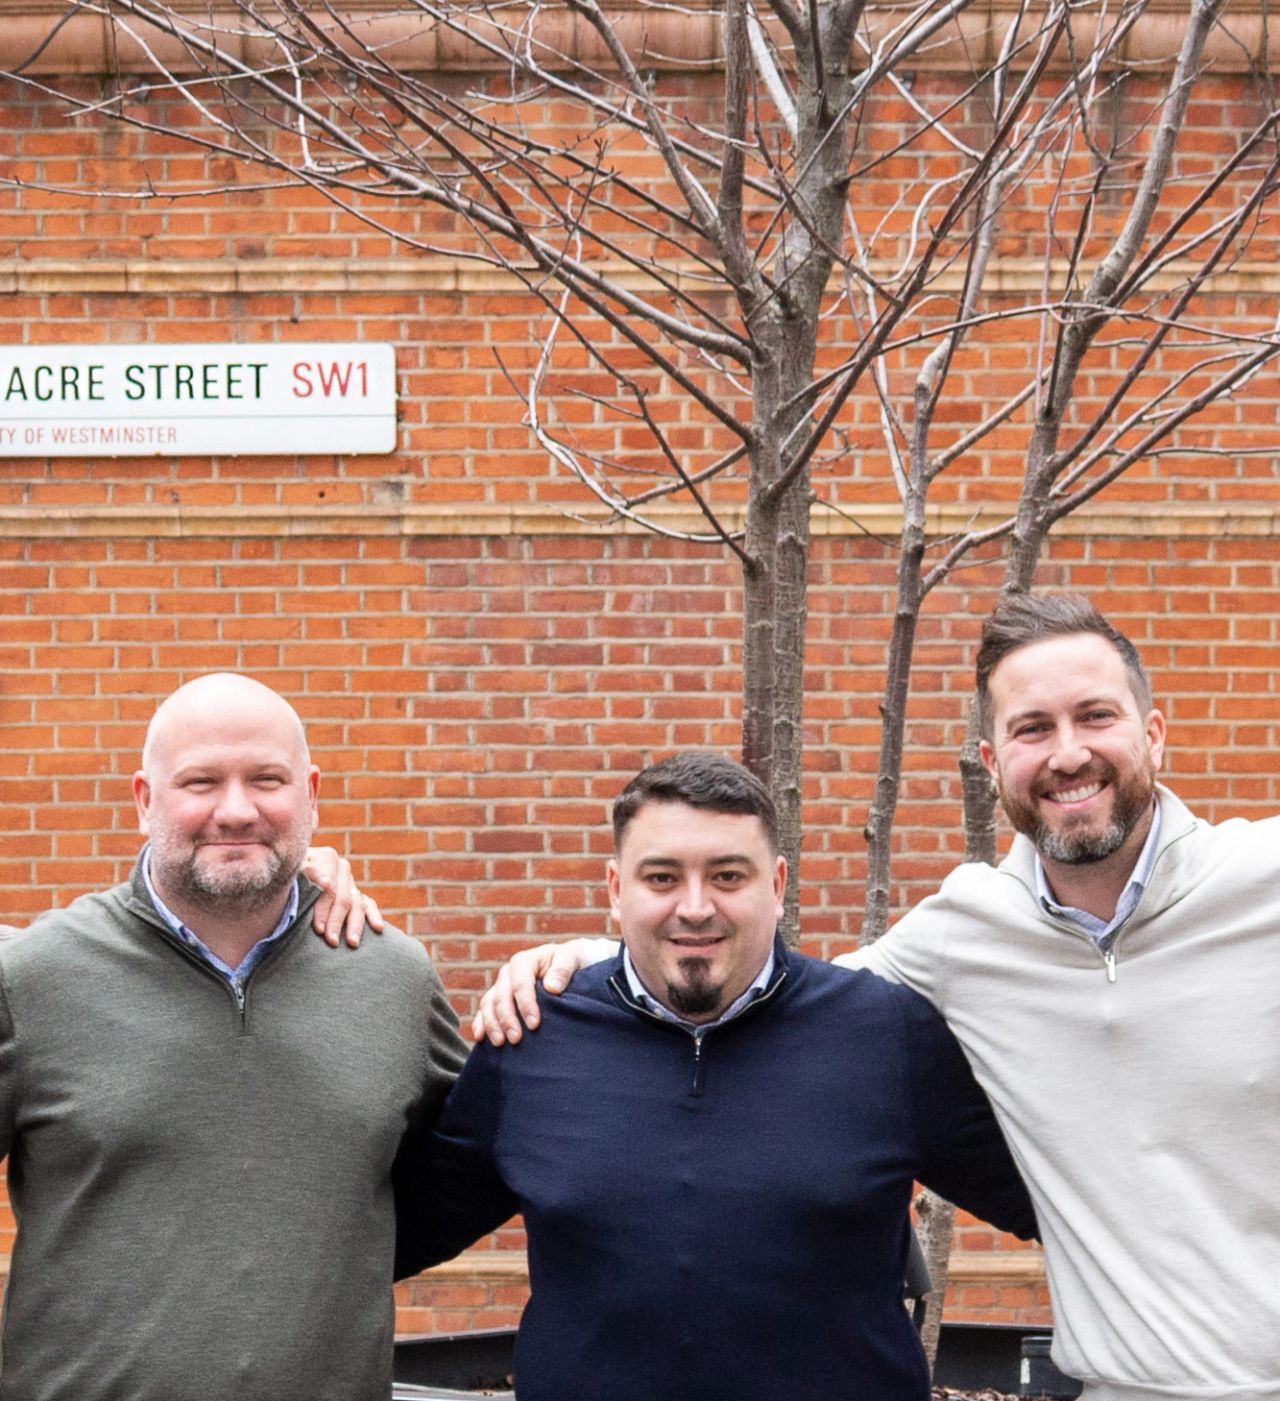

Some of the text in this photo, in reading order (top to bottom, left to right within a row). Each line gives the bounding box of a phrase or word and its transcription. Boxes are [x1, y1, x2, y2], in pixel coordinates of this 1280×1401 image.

[125, 364, 268, 400] STREET
[292, 361, 368, 398] SW1
[24, 426, 45, 445] OF
[51, 425, 178, 444] WESTMINSTER
